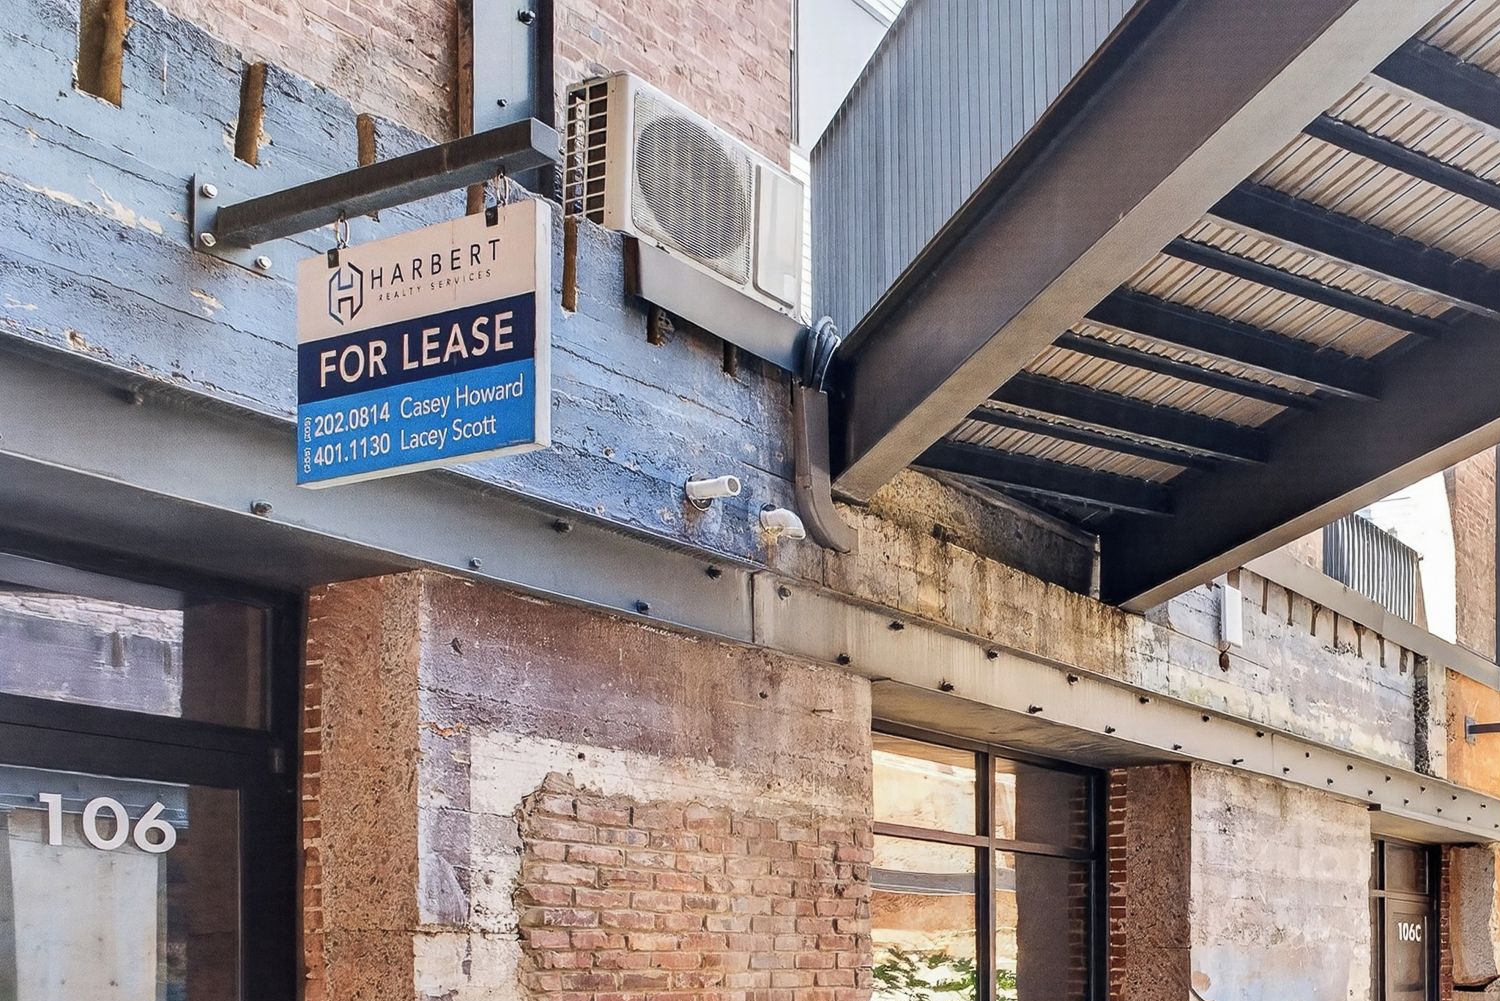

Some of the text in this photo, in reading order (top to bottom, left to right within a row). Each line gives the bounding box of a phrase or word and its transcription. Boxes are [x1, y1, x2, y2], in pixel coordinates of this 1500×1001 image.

[371, 239, 500, 289] HARBERT
[379, 269, 491, 301] REALTY SERVICES
[320, 310, 514, 387] FOR LEASE
[314, 372, 524, 437] 202.0814 Casey Howard
[314, 415, 497, 466] 401.1130 Lacey Scott
[39, 792, 177, 853] 106
[1398, 922, 1422, 942] 106C
